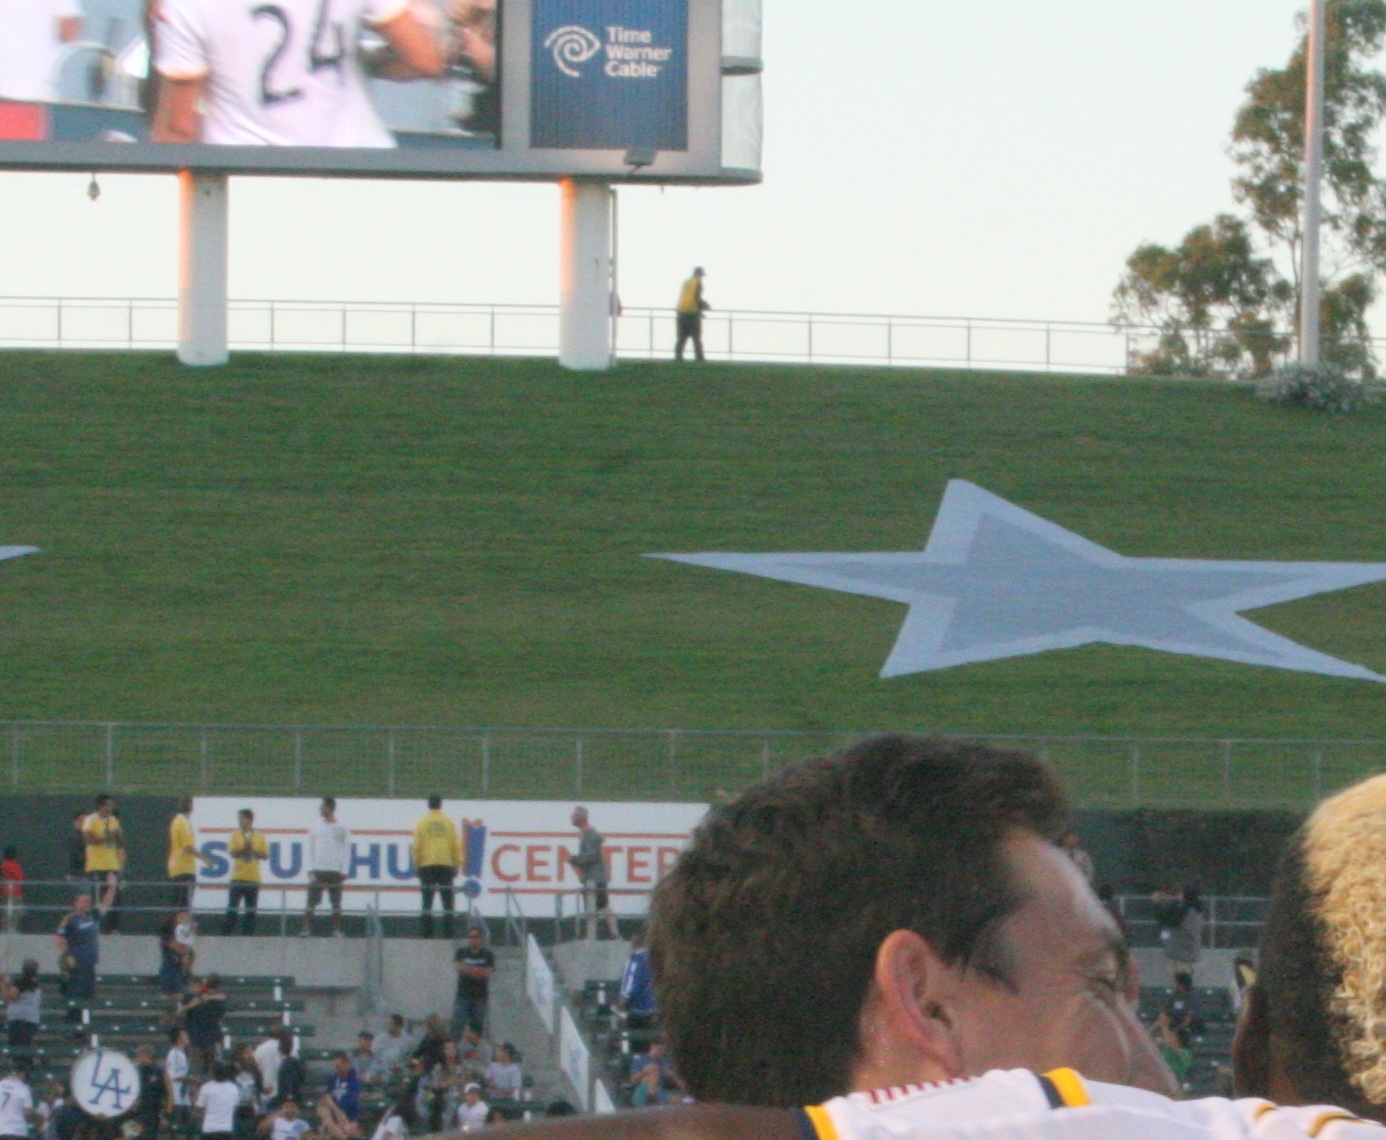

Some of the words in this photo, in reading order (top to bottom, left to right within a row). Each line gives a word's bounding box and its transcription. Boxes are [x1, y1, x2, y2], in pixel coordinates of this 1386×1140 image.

[604, 26, 652, 43] Time
[249, 0, 345, 107] 24
[605, 43, 673, 60] Warner
[605, 60, 658, 77] Cable
